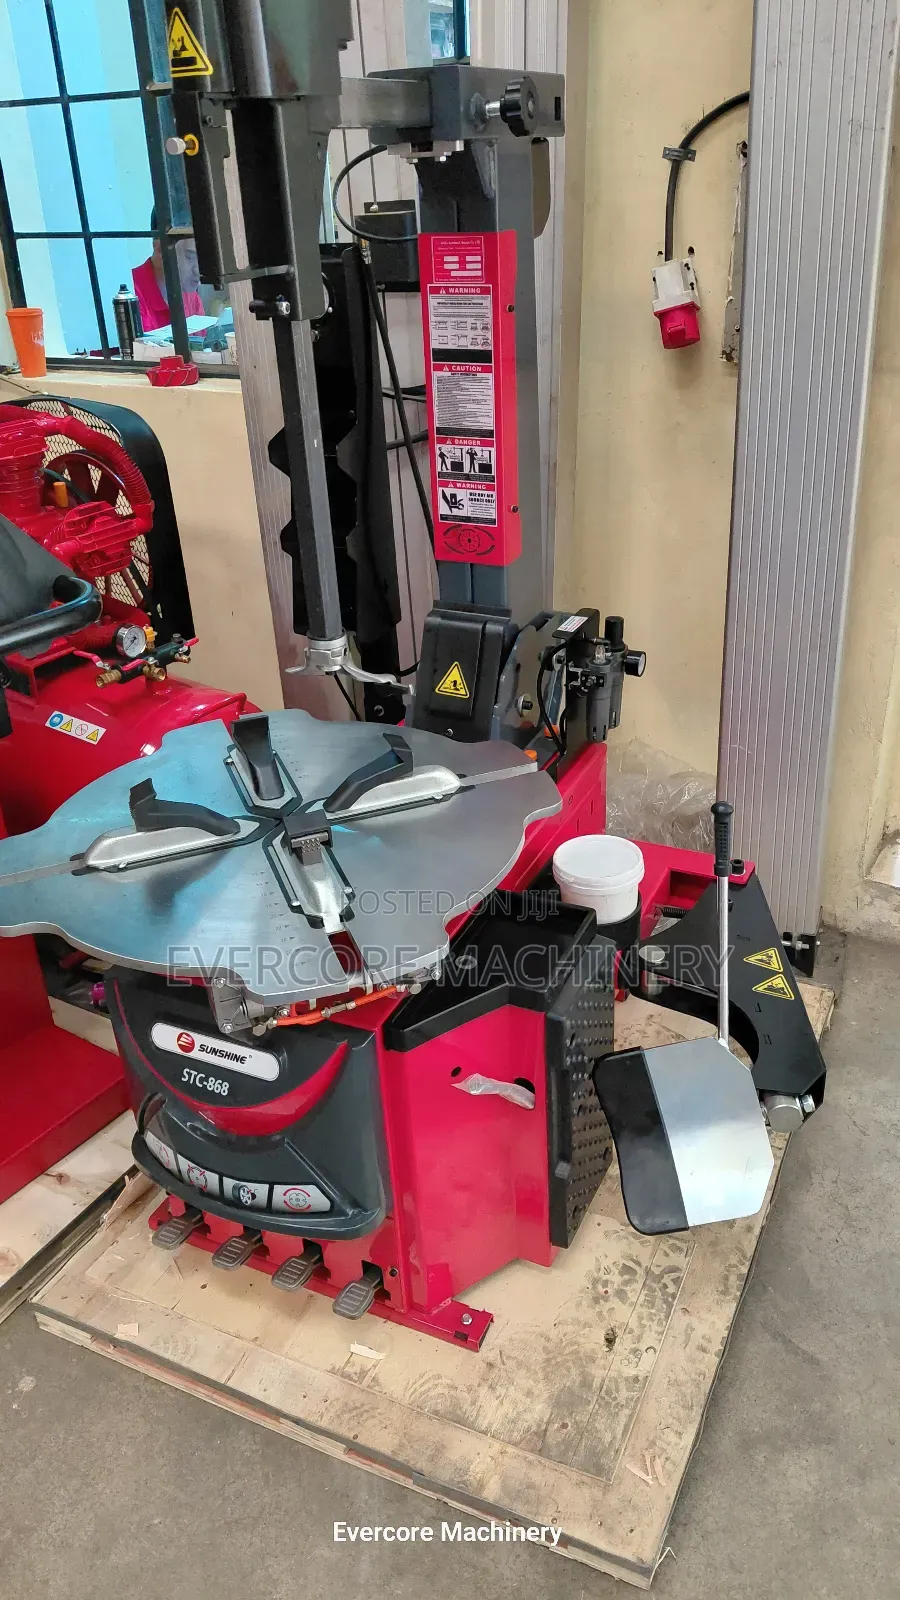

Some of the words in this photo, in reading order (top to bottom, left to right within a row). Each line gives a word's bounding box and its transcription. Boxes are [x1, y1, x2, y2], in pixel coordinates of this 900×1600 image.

[456, 482, 487, 490] WARNING
[198, 1043, 248, 1065] SUNSHINE
[181, 1067, 230, 1097] STC-868
